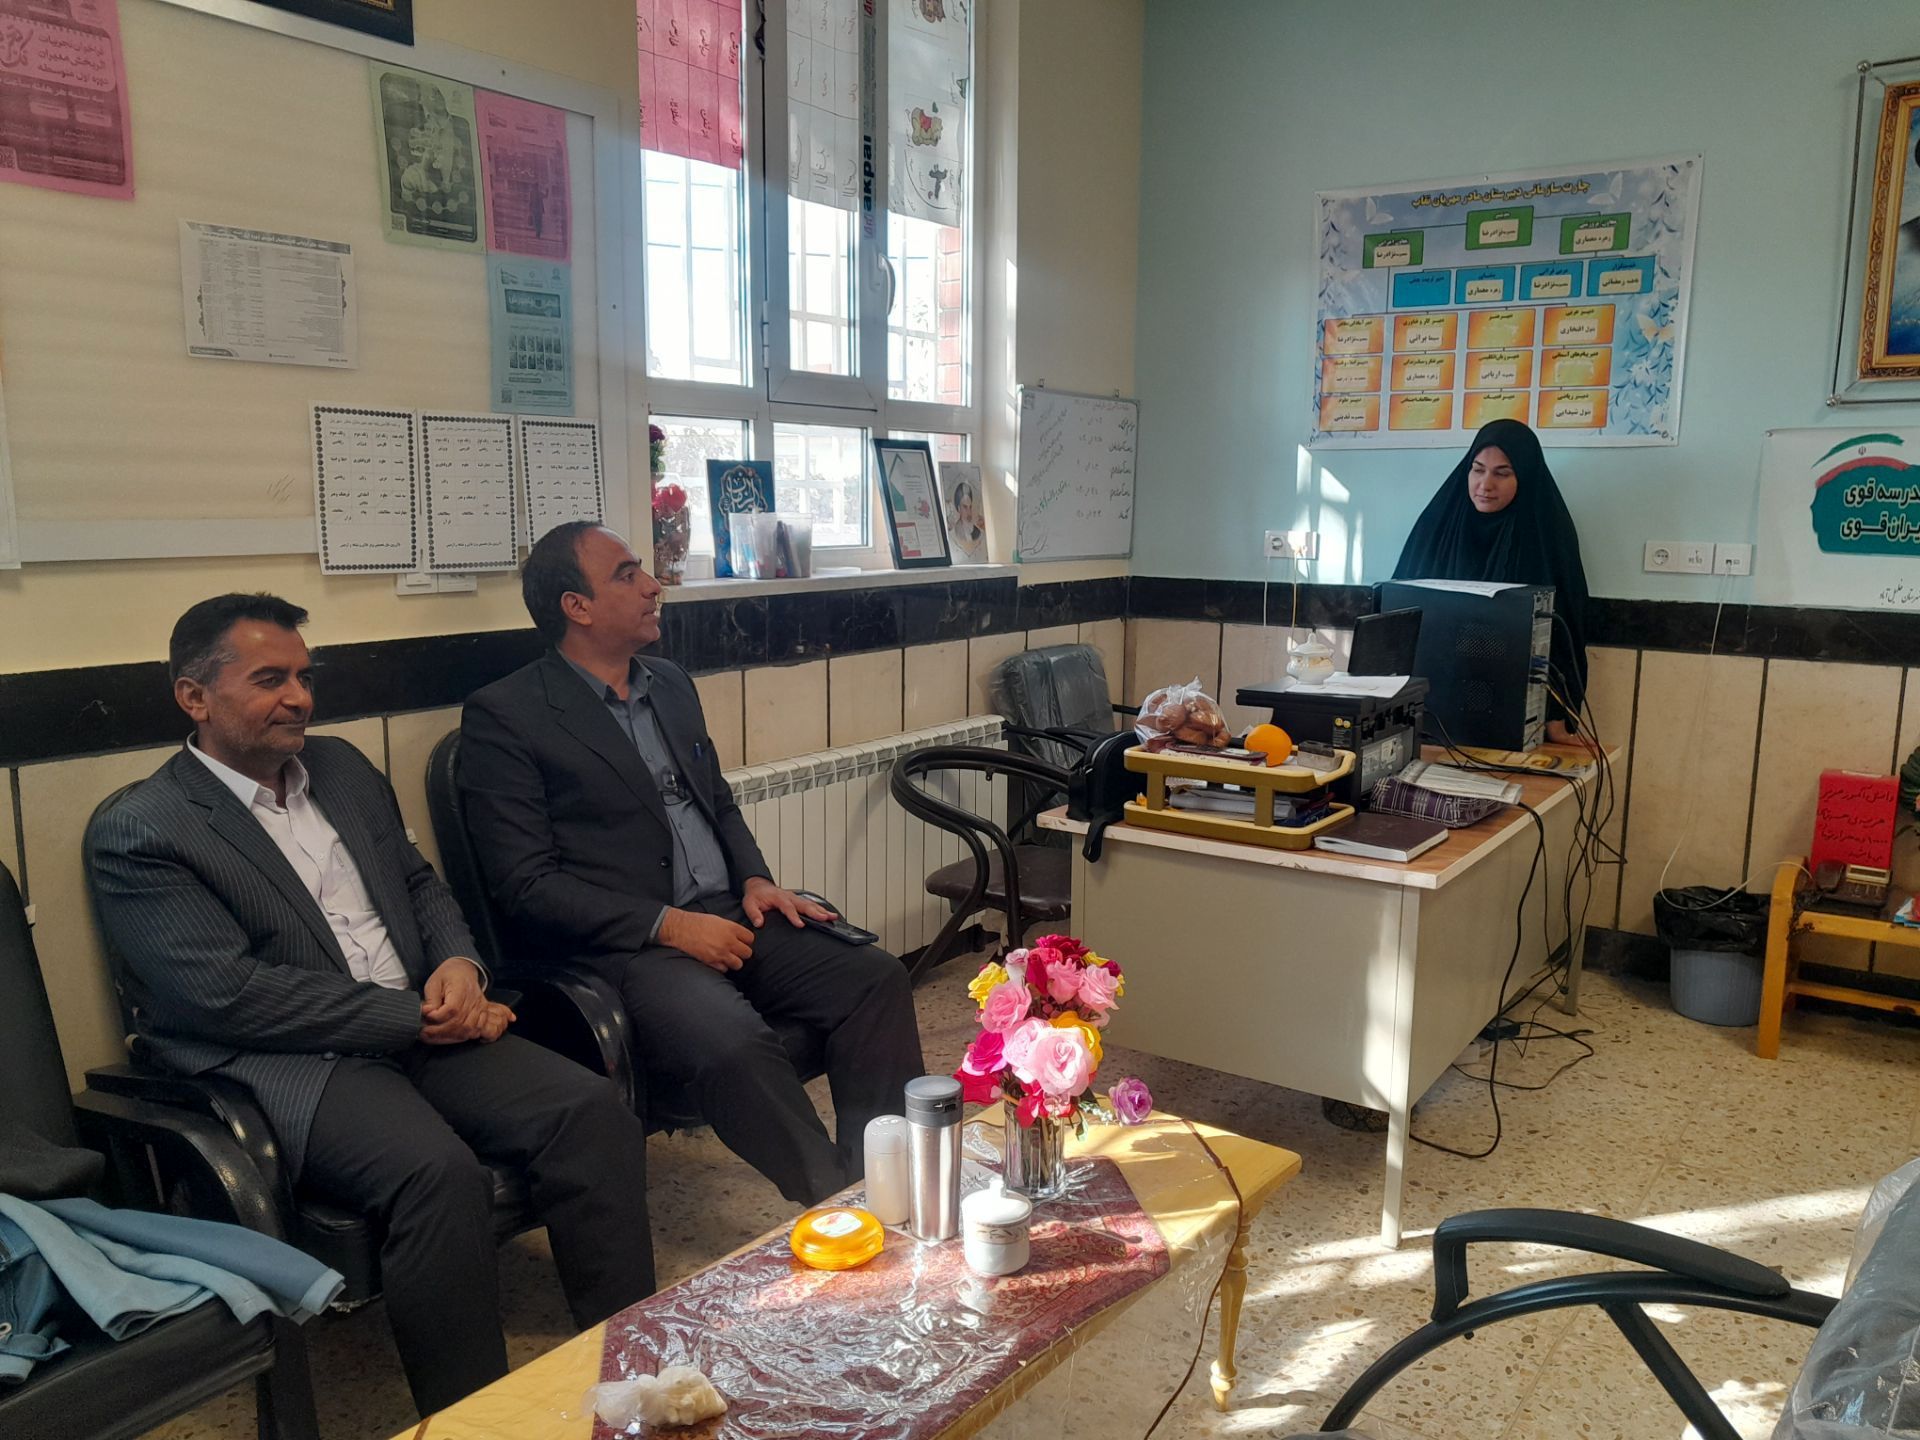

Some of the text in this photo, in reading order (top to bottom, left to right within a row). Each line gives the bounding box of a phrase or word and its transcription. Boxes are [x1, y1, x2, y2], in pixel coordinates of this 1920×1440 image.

[1483, 186, 1523, 202] دبیرستان
[1523, 182, 1562, 199] سازمانی
[1561, 178, 1591, 195] چارت
[1844, 478, 1920, 508] درسه قوی
[1840, 511, 1920, 543] یران قوی
